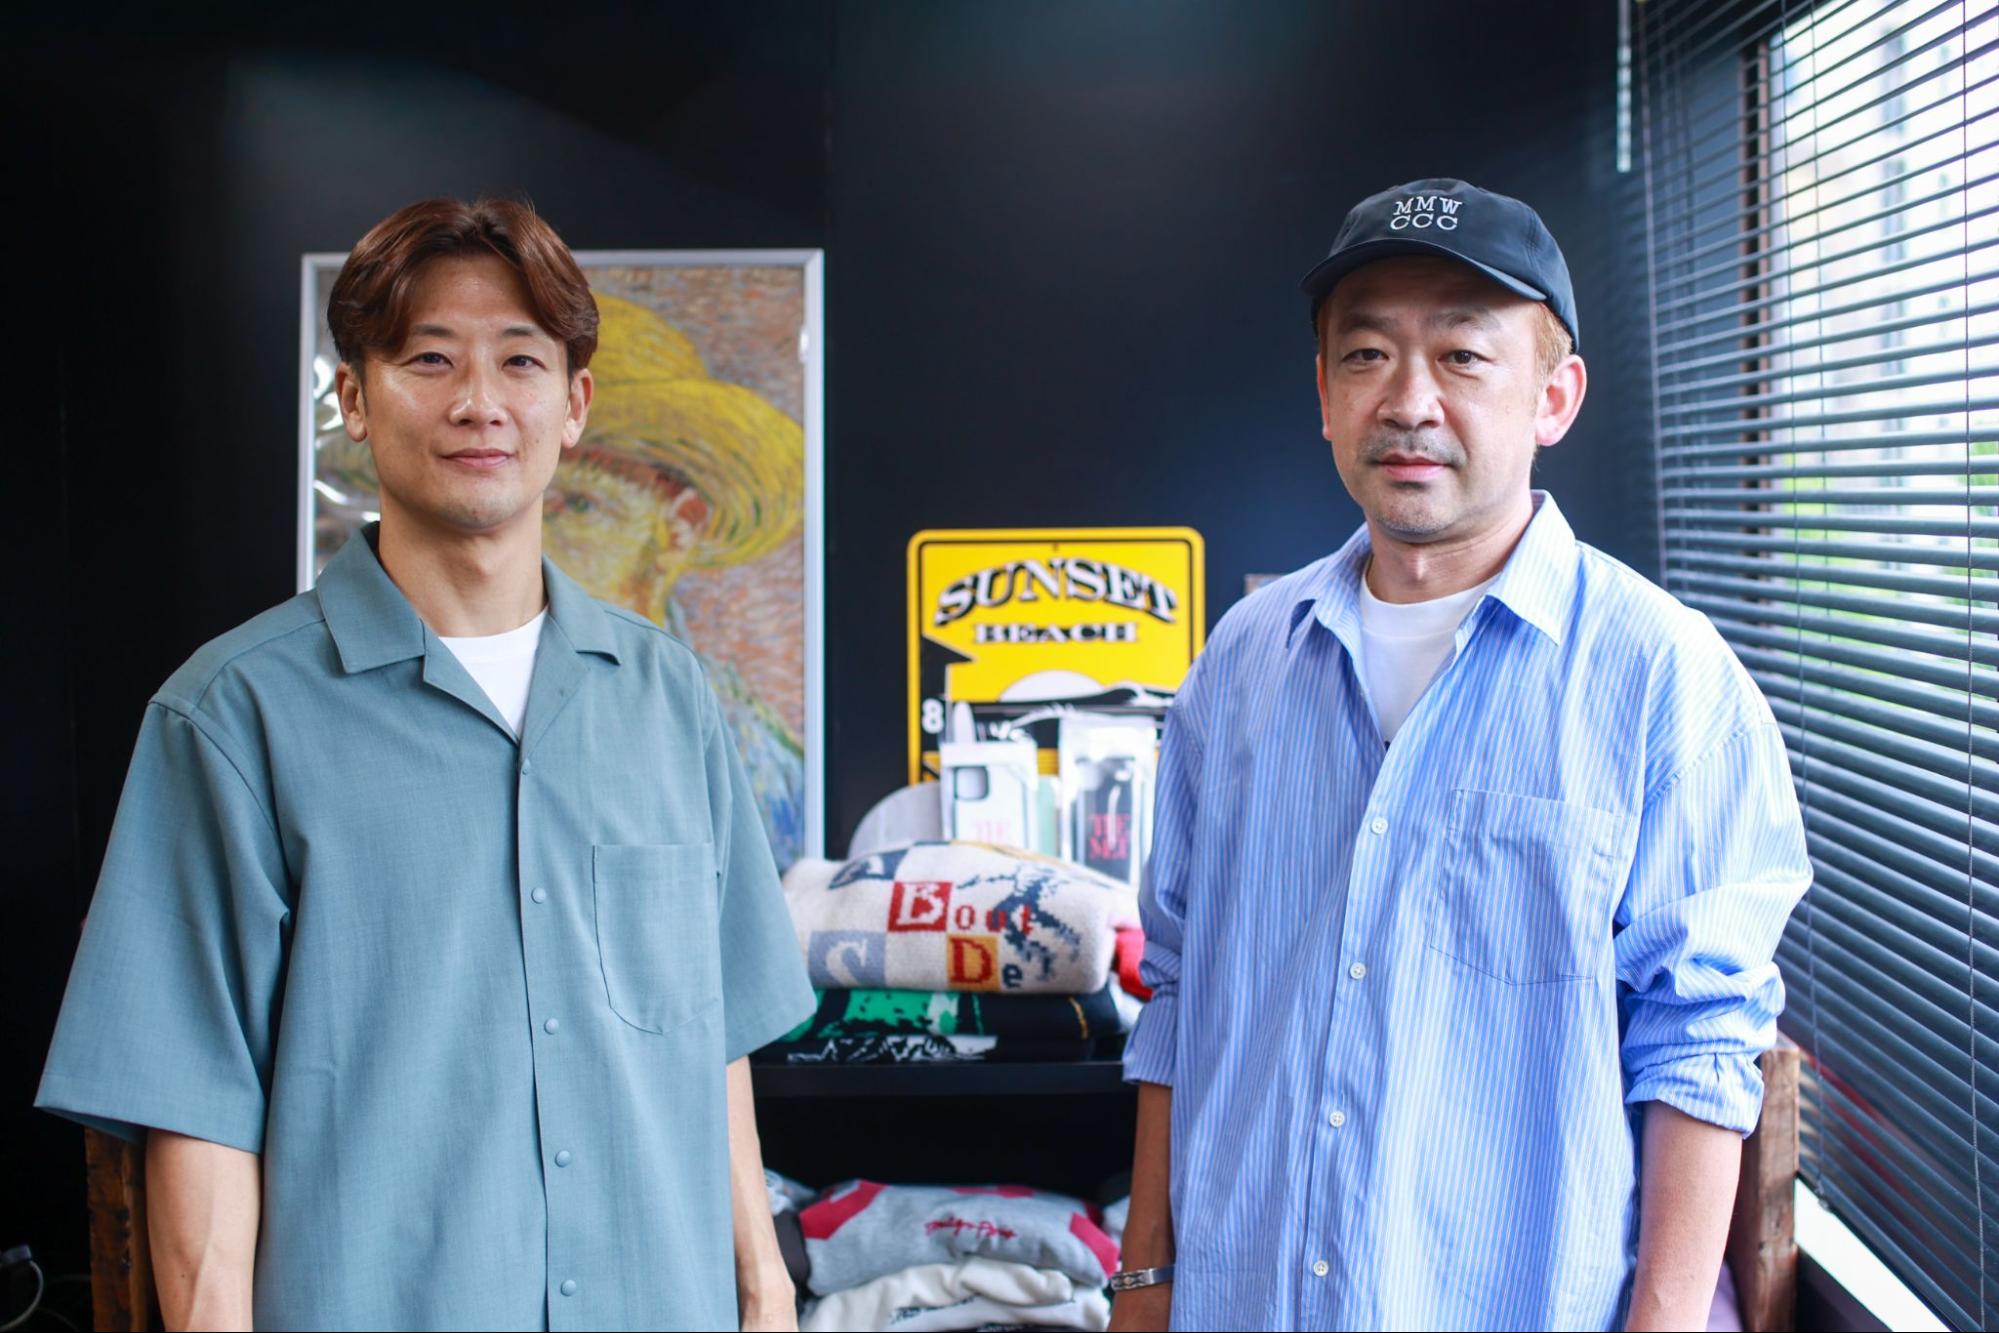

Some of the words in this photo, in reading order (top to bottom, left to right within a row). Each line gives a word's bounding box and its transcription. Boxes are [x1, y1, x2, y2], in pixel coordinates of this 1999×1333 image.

[1392, 195, 1463, 215] MMW
[1390, 213, 1458, 231] CCC
[934, 557, 1177, 627] SUNSET
[973, 623, 1139, 644] BEACH
